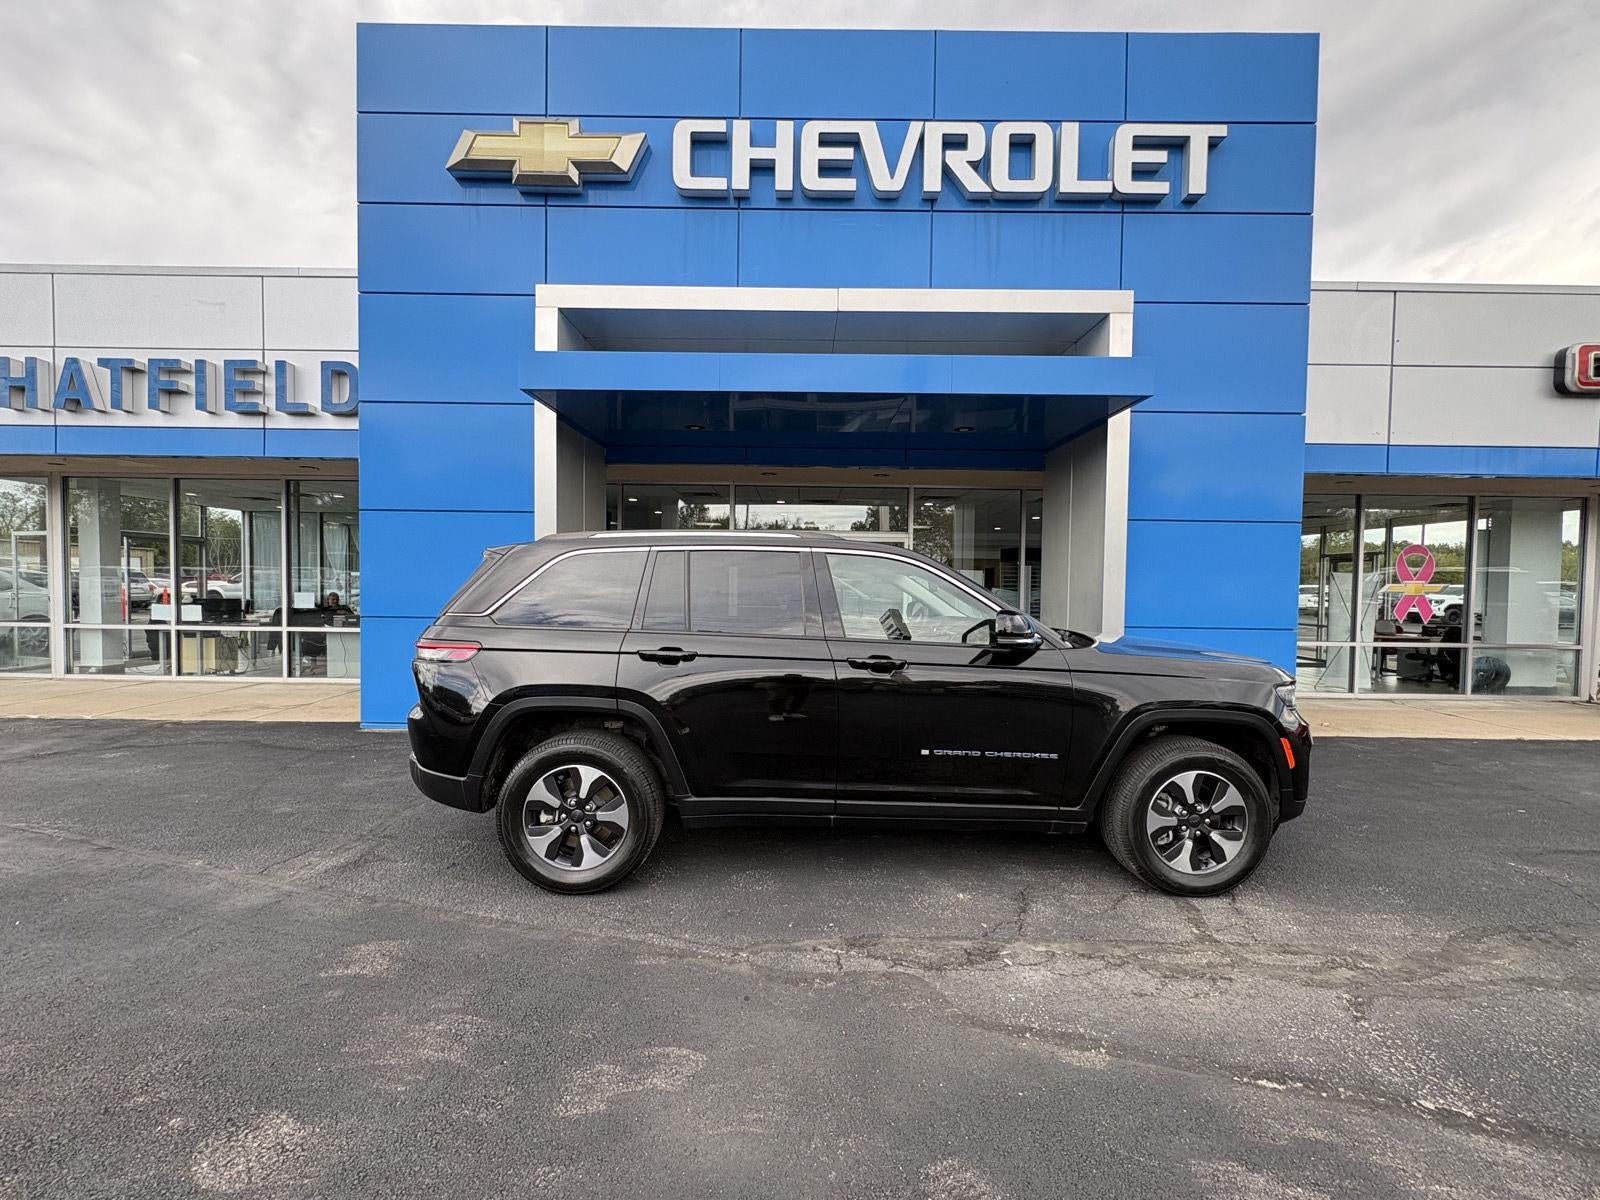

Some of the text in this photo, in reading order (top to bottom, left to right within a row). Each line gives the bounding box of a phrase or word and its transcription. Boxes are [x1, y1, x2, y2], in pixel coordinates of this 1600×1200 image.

[672, 119, 1228, 199] CHEVROLET
[0, 355, 359, 415] HATFIELD
[933, 749, 1059, 760] GRAND CHEROKEE
